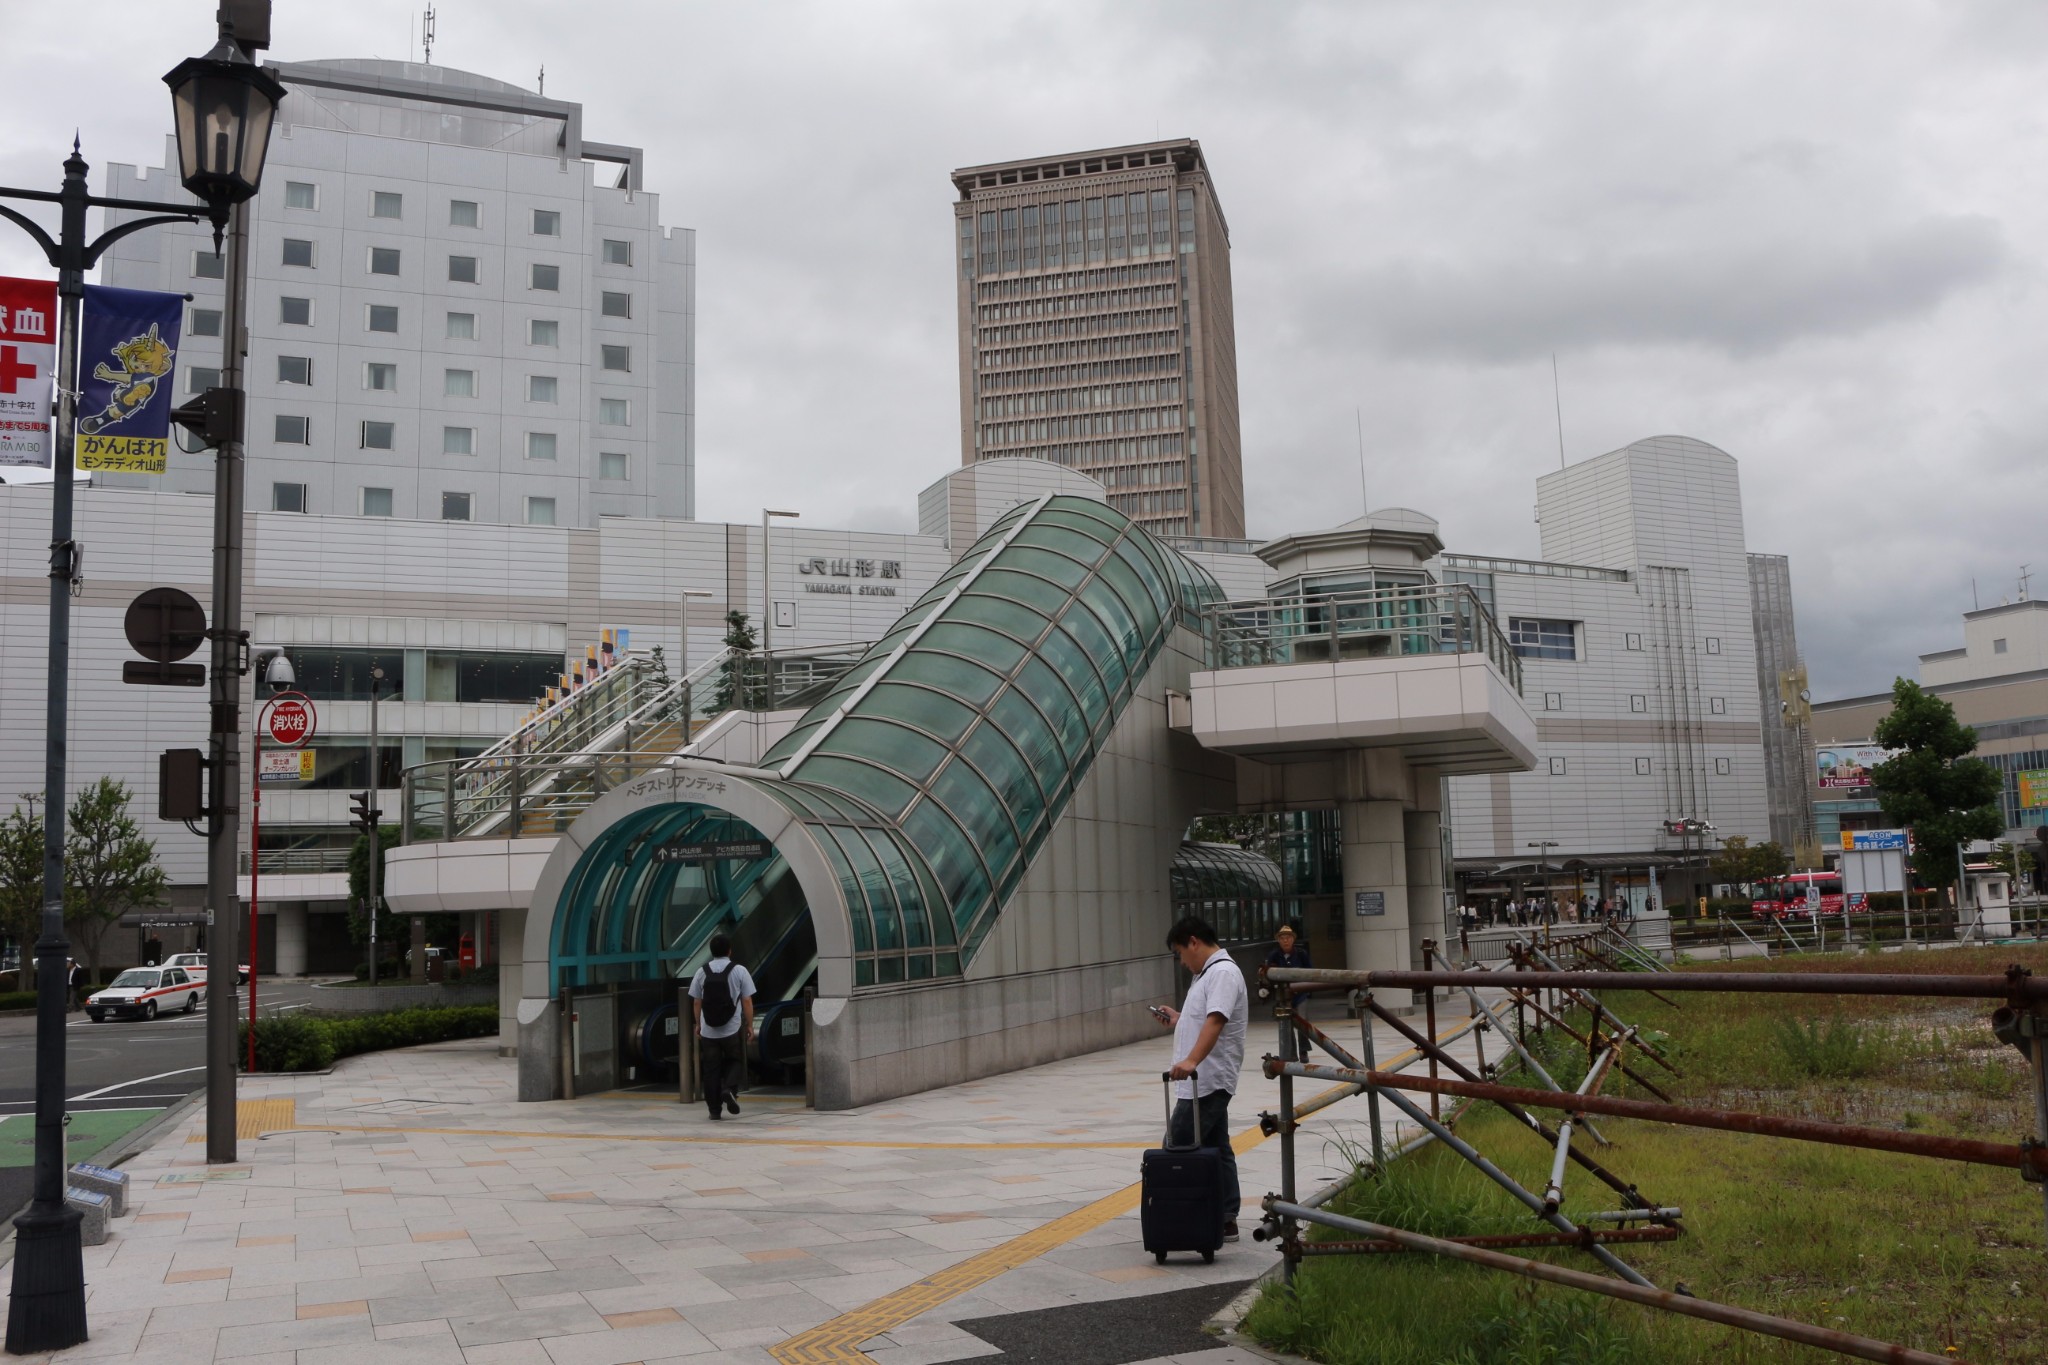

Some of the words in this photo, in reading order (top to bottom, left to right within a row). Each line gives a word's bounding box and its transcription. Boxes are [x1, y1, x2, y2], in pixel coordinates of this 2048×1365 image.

[84, 437, 166, 456] がんばれ
[82, 456, 166, 472] モンテディオ山形
[799, 558, 902, 579] JR山形駅
[805, 583, 852, 595] YAMAGATA
[858, 586, 896, 597] STATION
[273, 713, 306, 731] 消火栓
[1857, 750, 1873, 758] With
[626, 775, 727, 797] ペデストリアンデッキ
[645, 791, 687, 802] PEDESTRIAN
[689, 791, 706, 801] DECK
[1868, 831, 1892, 840] AEON
[1855, 841, 1904, 850] 英会話イーオン
